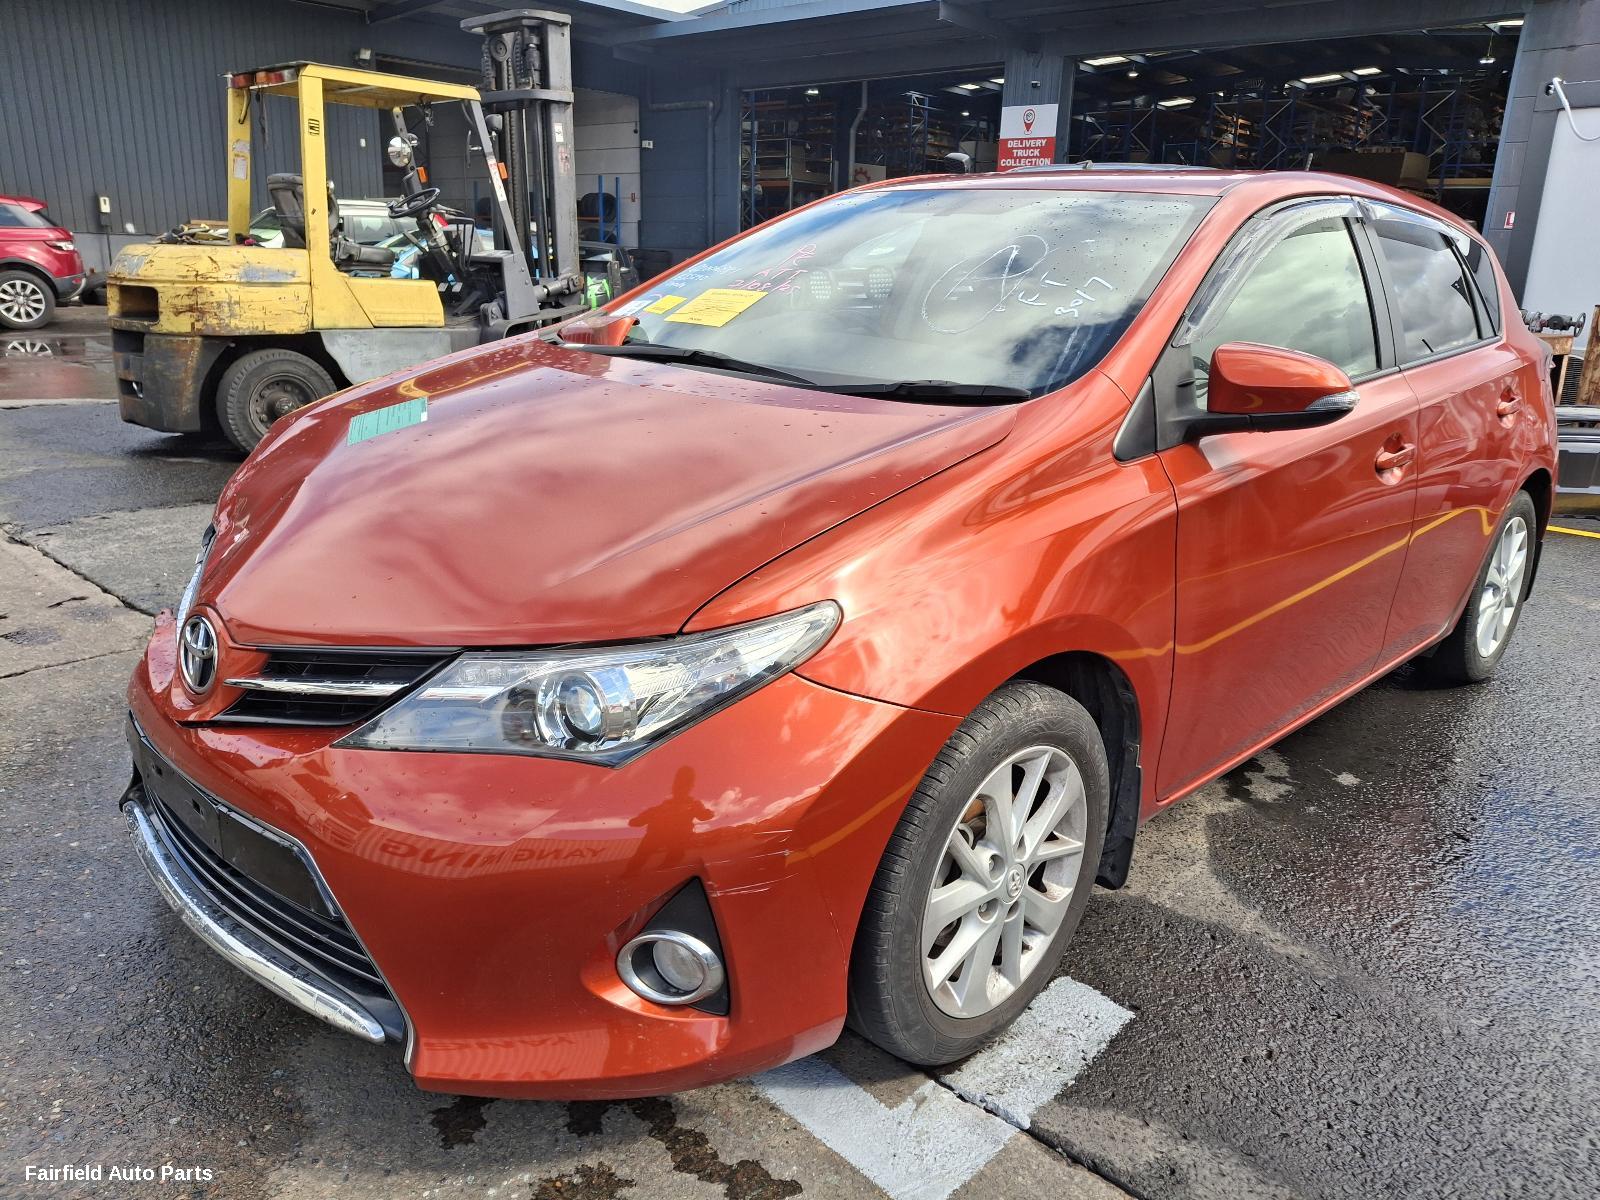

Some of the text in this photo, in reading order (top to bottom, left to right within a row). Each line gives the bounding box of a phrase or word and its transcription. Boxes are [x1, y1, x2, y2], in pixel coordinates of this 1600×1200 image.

[1007, 139, 1047, 148] DELIVERY
[1012, 149, 1040, 157] TRUCK
[1000, 158, 1051, 167] COLLECTION
